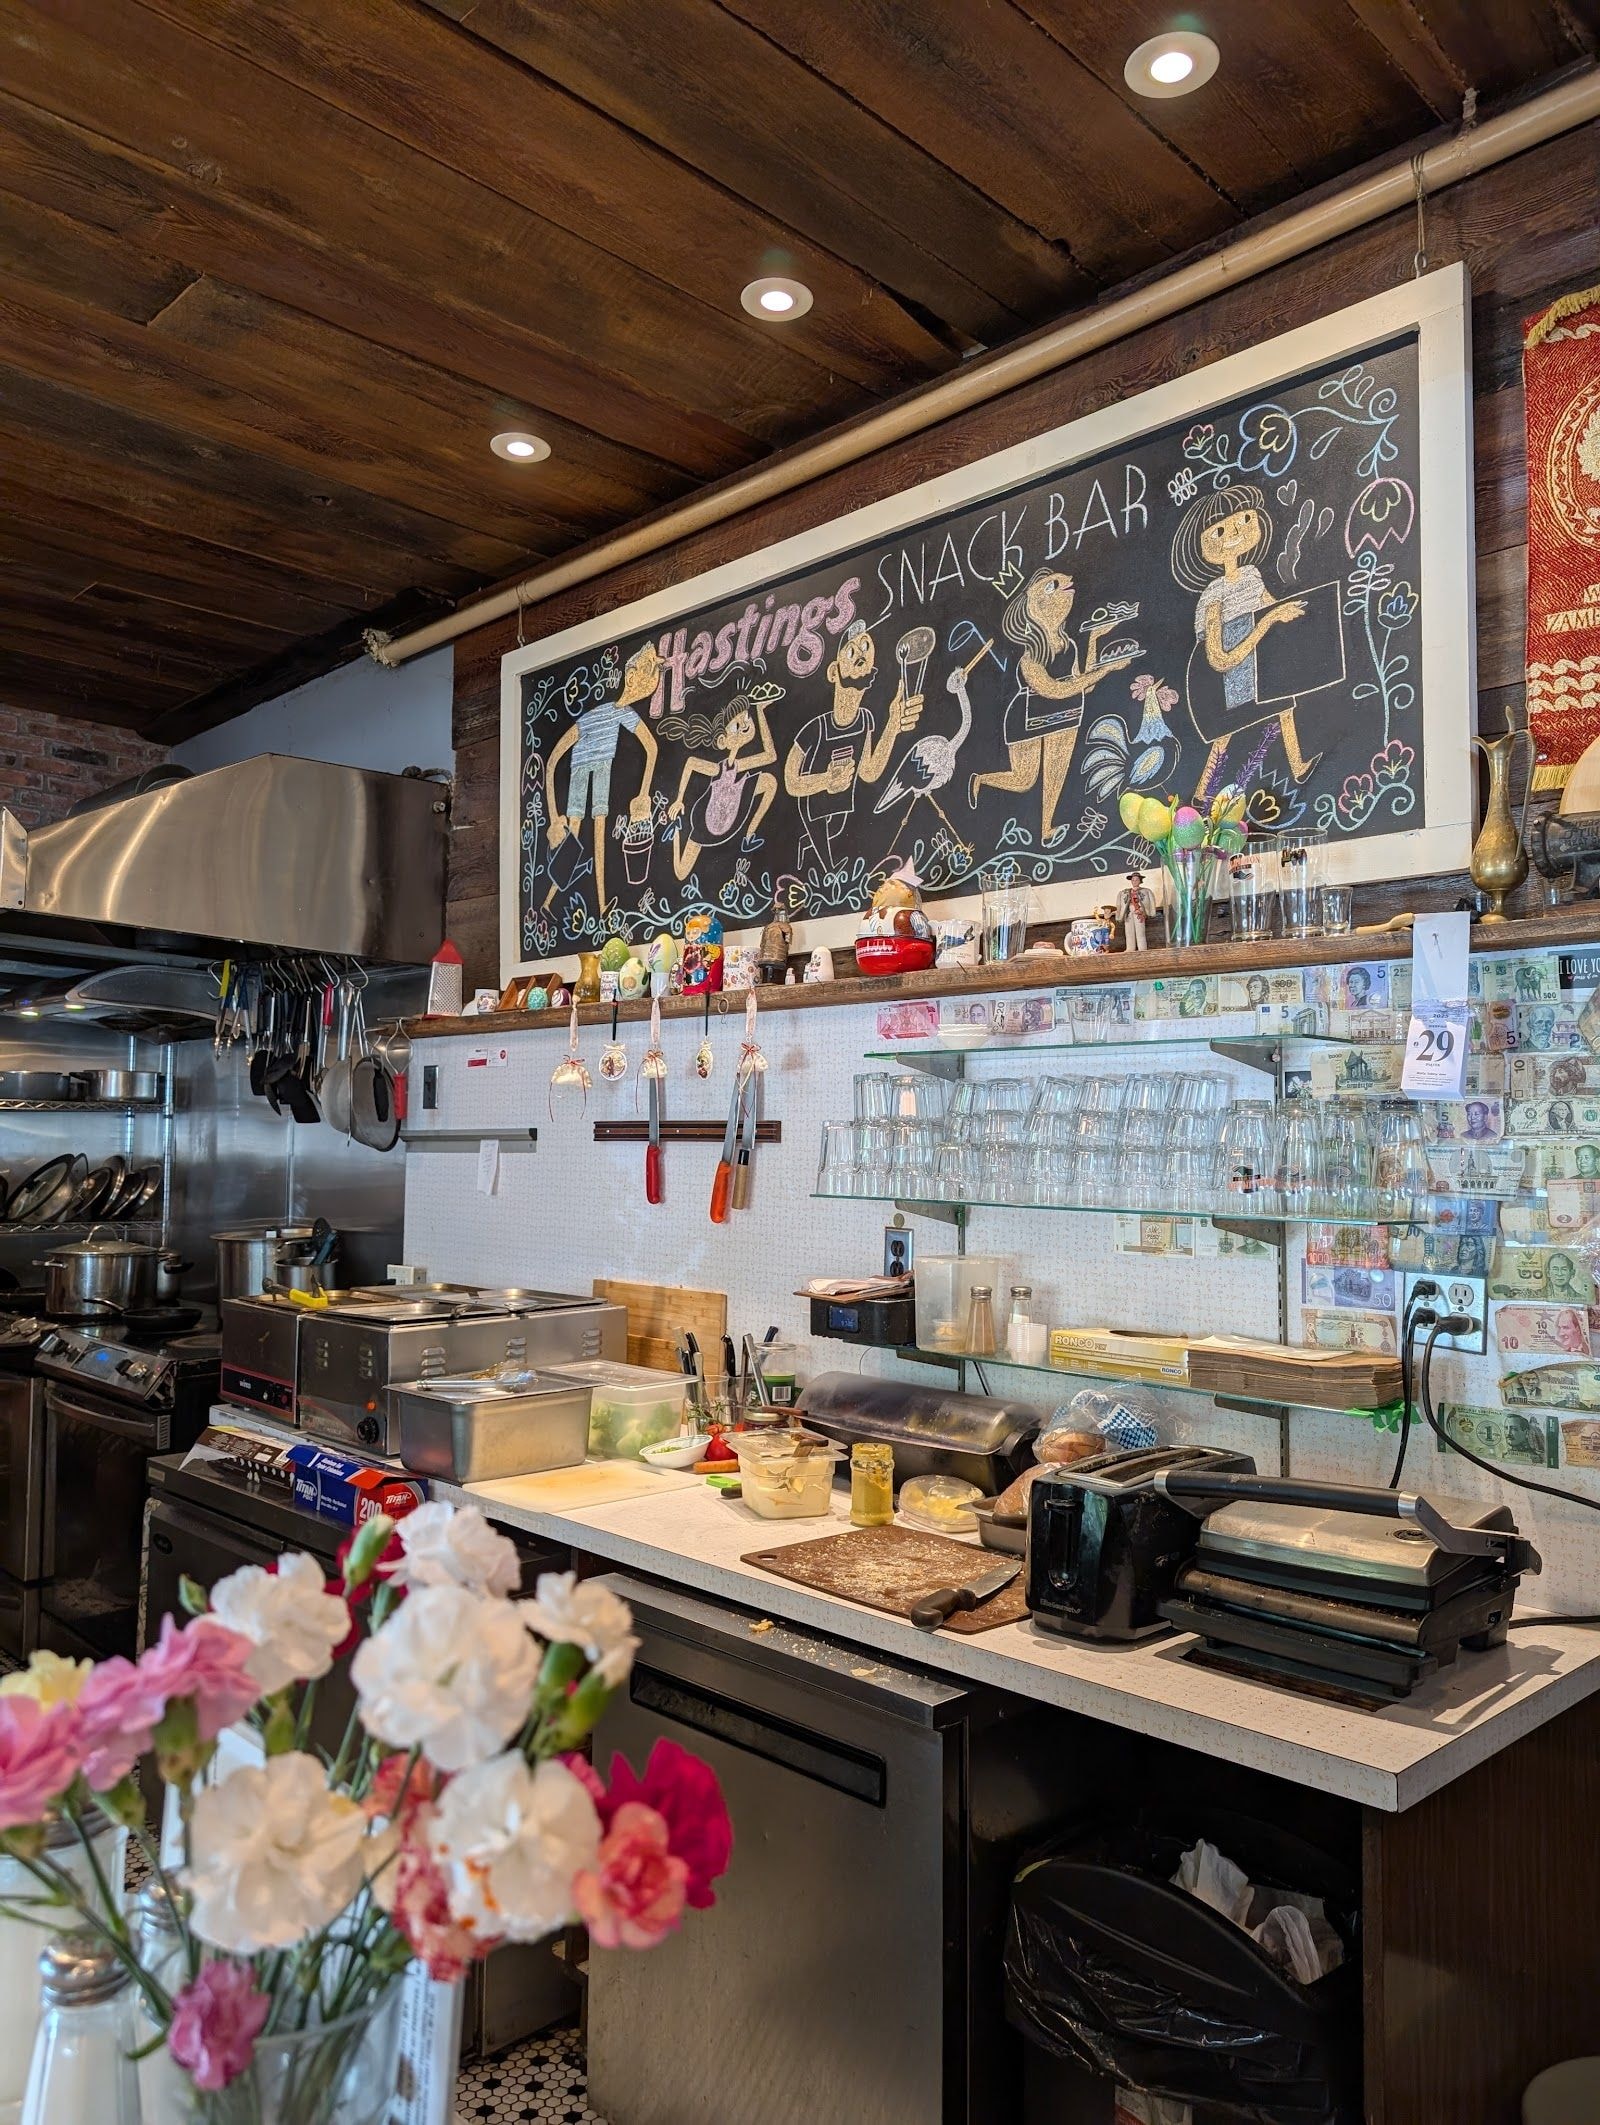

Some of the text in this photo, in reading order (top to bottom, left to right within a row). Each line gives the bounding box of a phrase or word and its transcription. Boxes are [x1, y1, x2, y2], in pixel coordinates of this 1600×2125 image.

[649, 464, 1147, 718] Hastings SNACK BAR
[1376, 965, 1386, 979] 5
[1566, 958, 1588, 975] LOVE
[1274, 979, 1293, 988] 500
[997, 1001, 1005, 1014] 20
[1281, 1005, 1289, 1018] 5
[1506, 1031, 1516, 1045] 5
[1569, 1033, 1581, 1046] 2
[1416, 1030, 1455, 1062] 29
[1514, 1059, 1525, 1073] 10
[1441, 1112, 1449, 1121] 5
[1550, 1154, 1557, 1165] 1
[1307, 1252, 1330, 1264] 1000
[1373, 1293, 1392, 1307] 50
[1536, 1321, 1547, 1330] 10
[1054, 1335, 1095, 1350] RONCO
[1501, 1336, 1519, 1350] 10
[1161, 1367, 1182, 1375] RONCO
[1485, 1425, 1495, 1441] 1
[360, 1497, 383, 1521] 200
